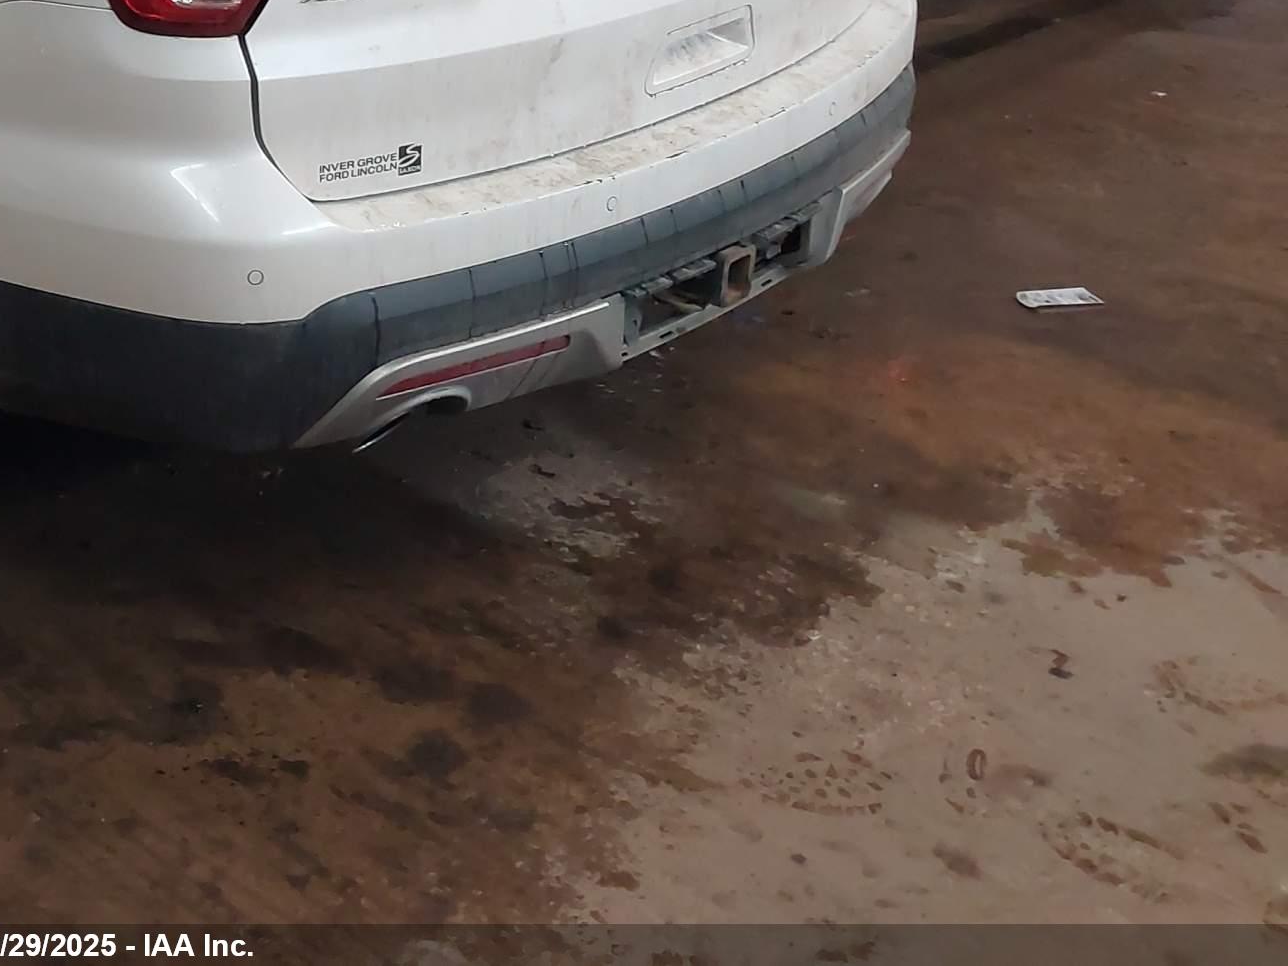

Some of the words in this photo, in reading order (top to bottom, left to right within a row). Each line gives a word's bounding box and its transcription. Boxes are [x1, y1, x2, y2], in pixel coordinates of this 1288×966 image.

[319, 160, 355, 174] INVER
[356, 153, 397, 168] GROVE
[319, 170, 350, 183] FORD
[350, 162, 398, 178] LINCOLN
